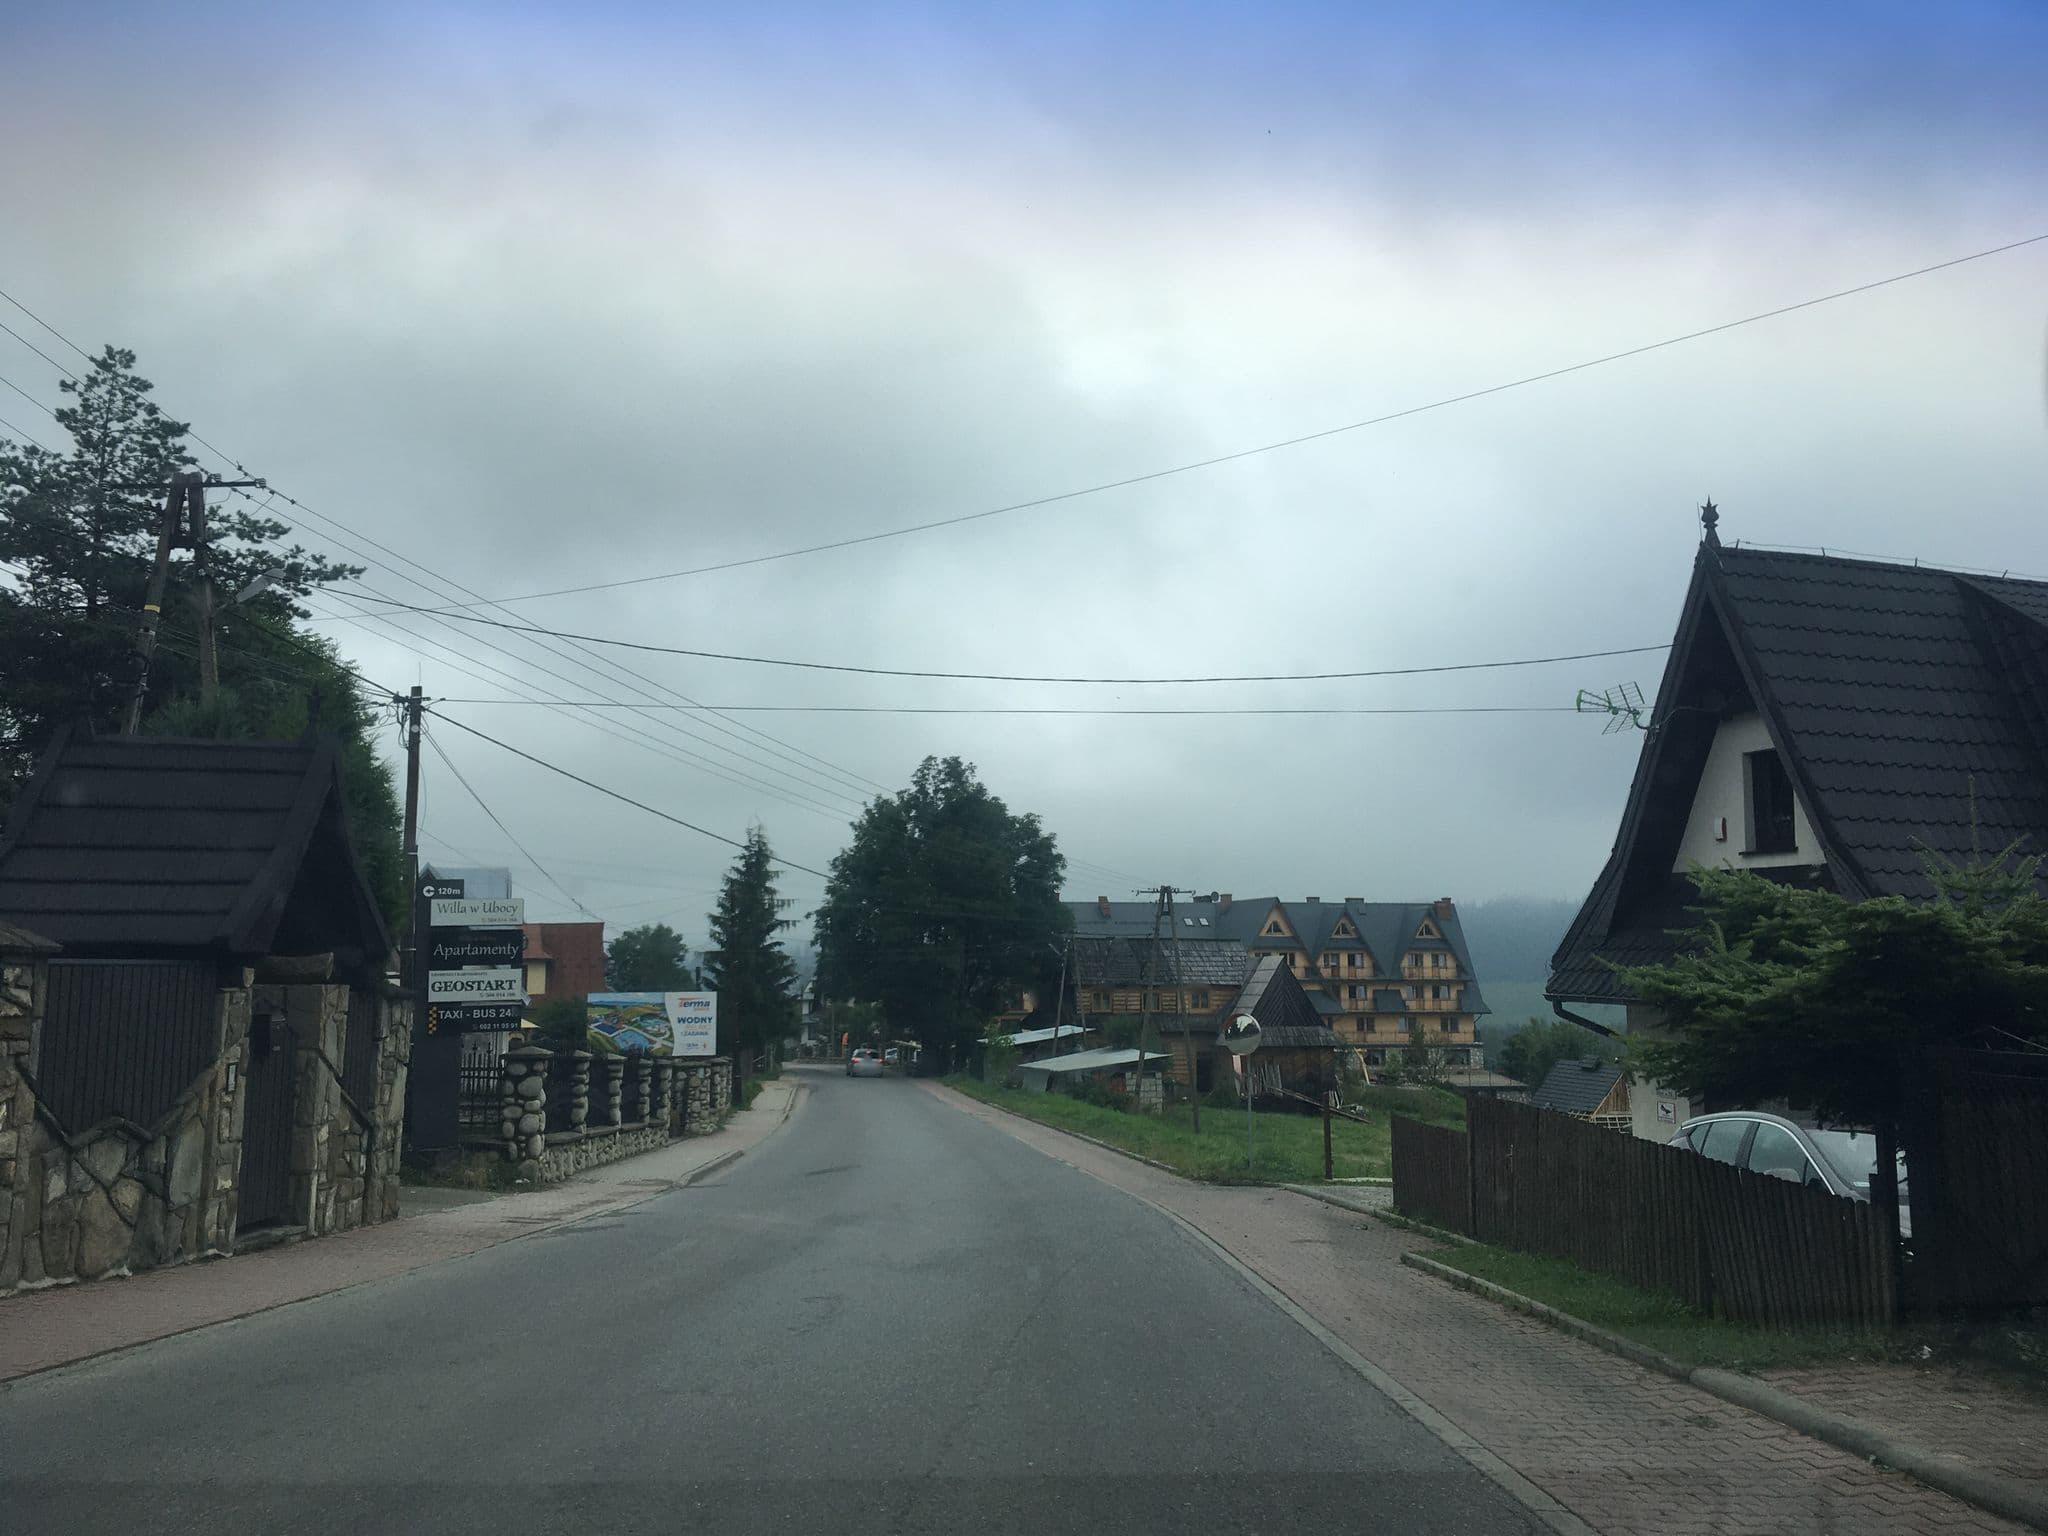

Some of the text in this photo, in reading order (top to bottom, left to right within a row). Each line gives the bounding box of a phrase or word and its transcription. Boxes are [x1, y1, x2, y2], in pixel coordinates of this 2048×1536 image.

[438, 887, 461, 895] 120m
[437, 901, 467, 914] Willa
[470, 905, 480, 913] w
[433, 943, 519, 961] Apartamenty
[431, 980, 517, 993] GEOSTART
[438, 1010, 464, 1019] TAXI
[472, 1009, 497, 1019] BUS
